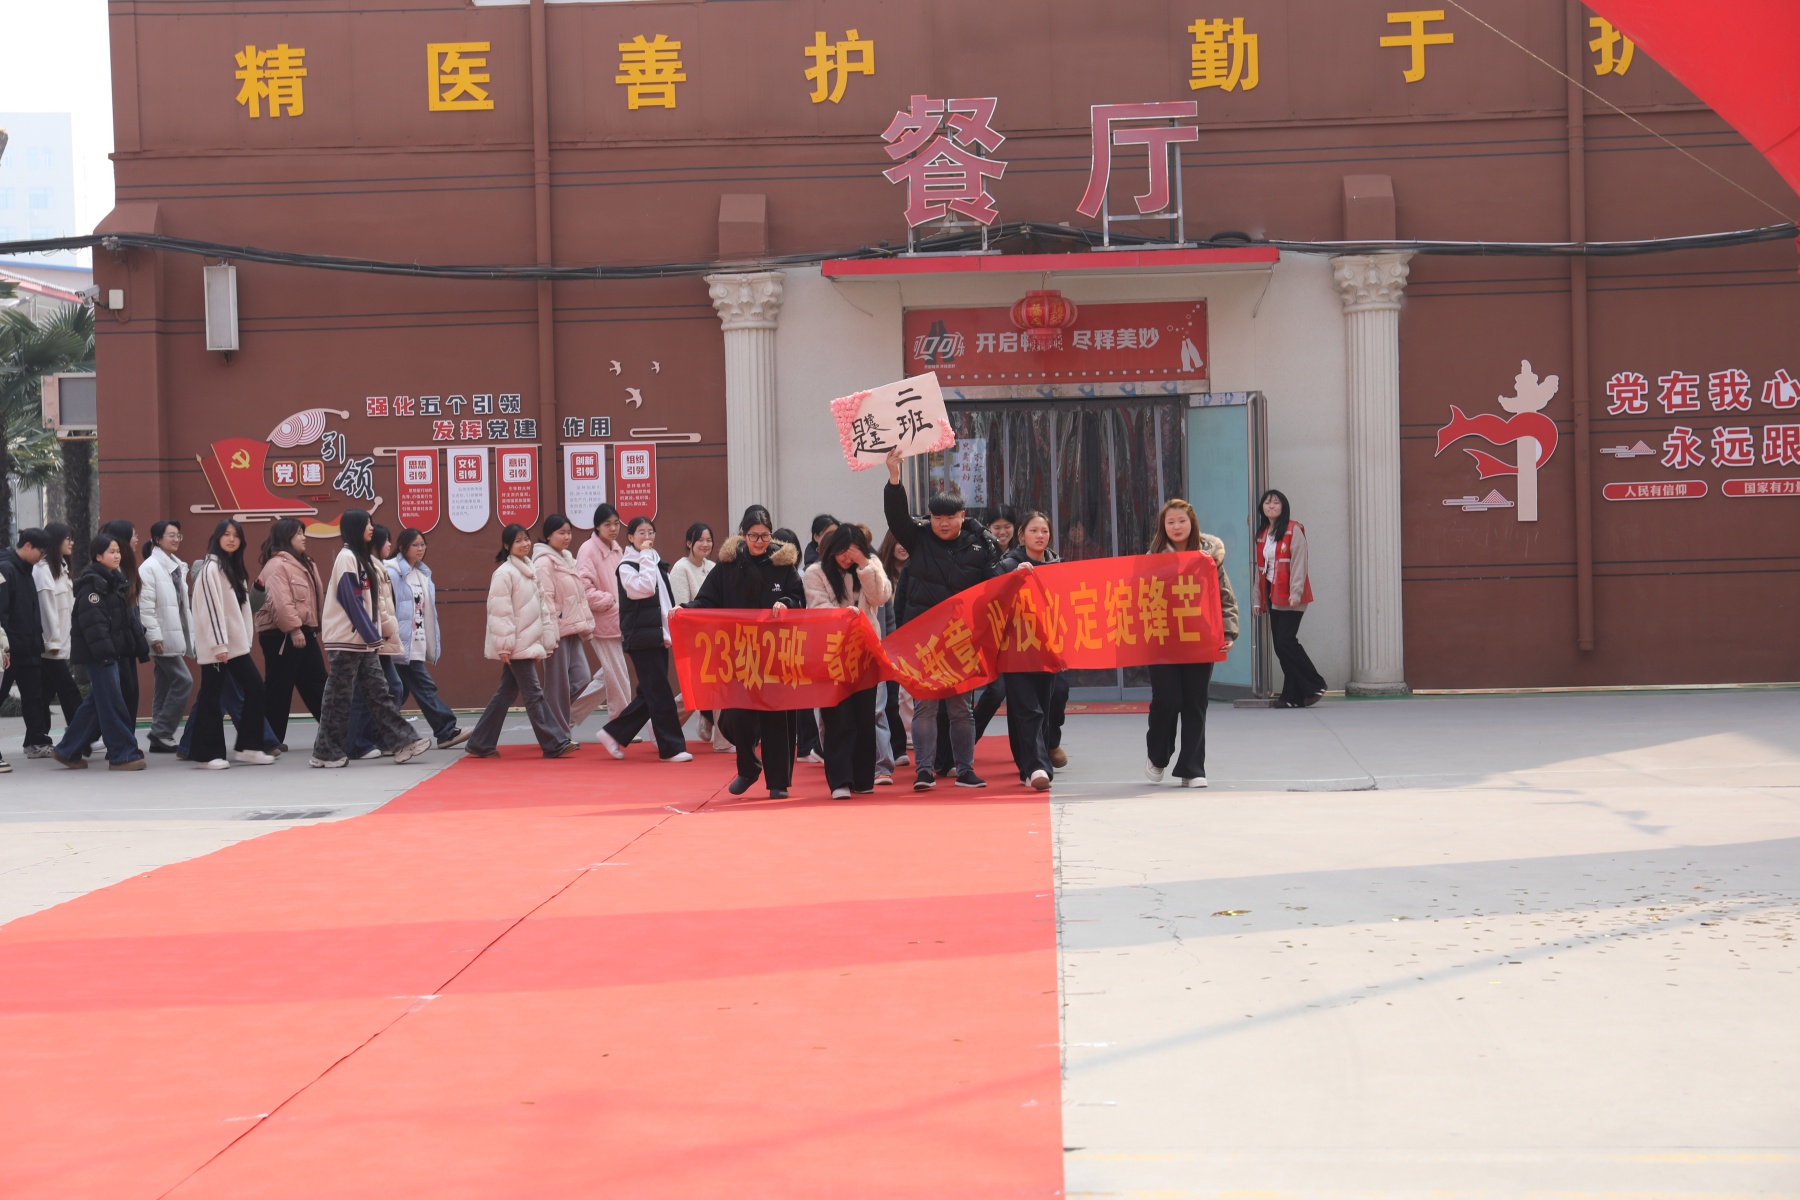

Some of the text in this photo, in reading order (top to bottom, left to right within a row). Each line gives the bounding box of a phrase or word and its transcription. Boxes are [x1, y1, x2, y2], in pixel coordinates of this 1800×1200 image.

[235, 28, 876, 119] 精医善护
[880, 94, 1200, 228] 餐厅
[1072, 328, 1160, 351] 尽释美妙
[1606, 368, 1800, 415] 党在我心
[366, 394, 521, 417] 强化五个引领
[433, 416, 611, 441] 发挥党建 作用
[321, 431, 376, 500] 引领
[408, 459, 428, 471] 思想
[457, 458, 477, 469] 文化
[508, 458, 527, 468] 意识
[575, 456, 595, 467] 创新
[626, 454, 645, 465] 组织
[275, 463, 323, 484] 党建
[408, 472, 428, 481] 引领
[458, 470, 477, 480] 引领
[508, 469, 528, 479] 引领
[575, 468, 595, 478] 引领
[626, 467, 645, 476] 引领
[1625, 484, 1688, 497] 人民有信仰
[694, 622, 811, 690] 23级2班
